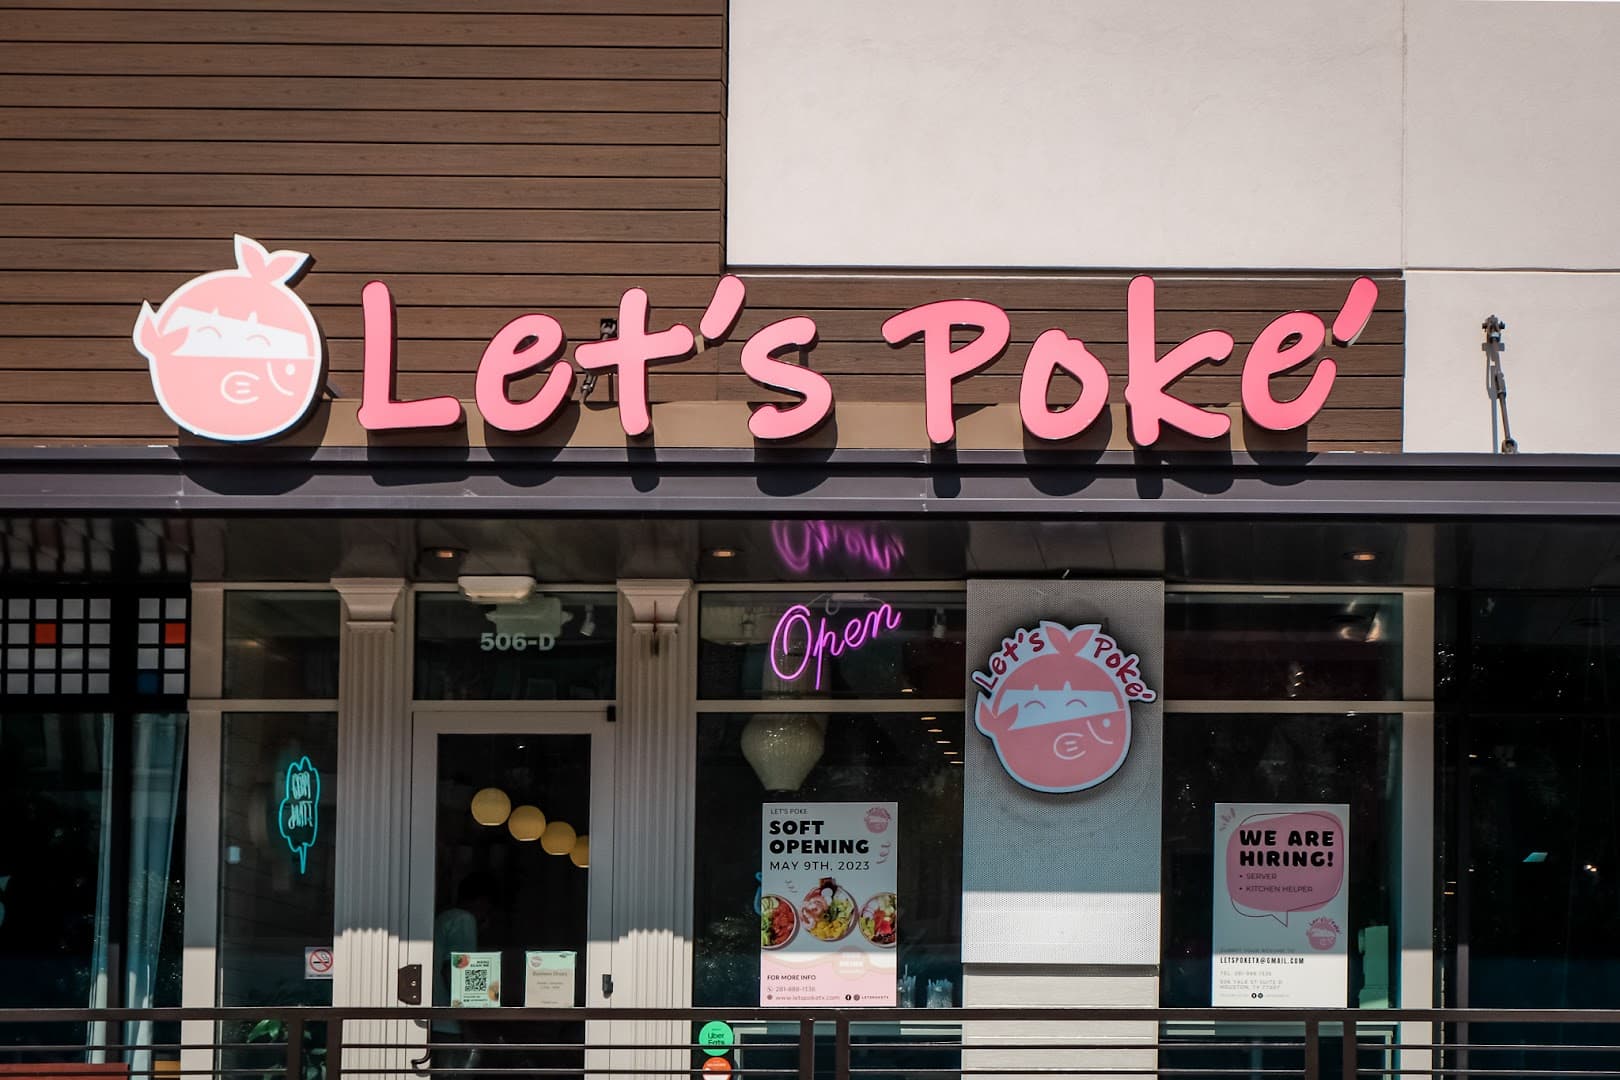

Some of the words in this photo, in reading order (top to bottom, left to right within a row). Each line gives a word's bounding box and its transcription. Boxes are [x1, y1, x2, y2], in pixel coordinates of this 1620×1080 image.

[357, 274, 832, 440] Let's
[480, 632, 556, 651] 506-D
[770, 603, 902, 690] Open
[975, 632, 1046, 690] Let's
[769, 820, 825, 835] SOFT
[769, 839, 870, 854] OPENING
[1239, 830, 1277, 846] WE
[1287, 830, 1335, 847] ARE
[769, 861, 799, 871] MAY
[838, 861, 870, 871] 2023
[1239, 850, 1334, 867] HIRING!
[1246, 885, 1280, 893] KITCHEN
